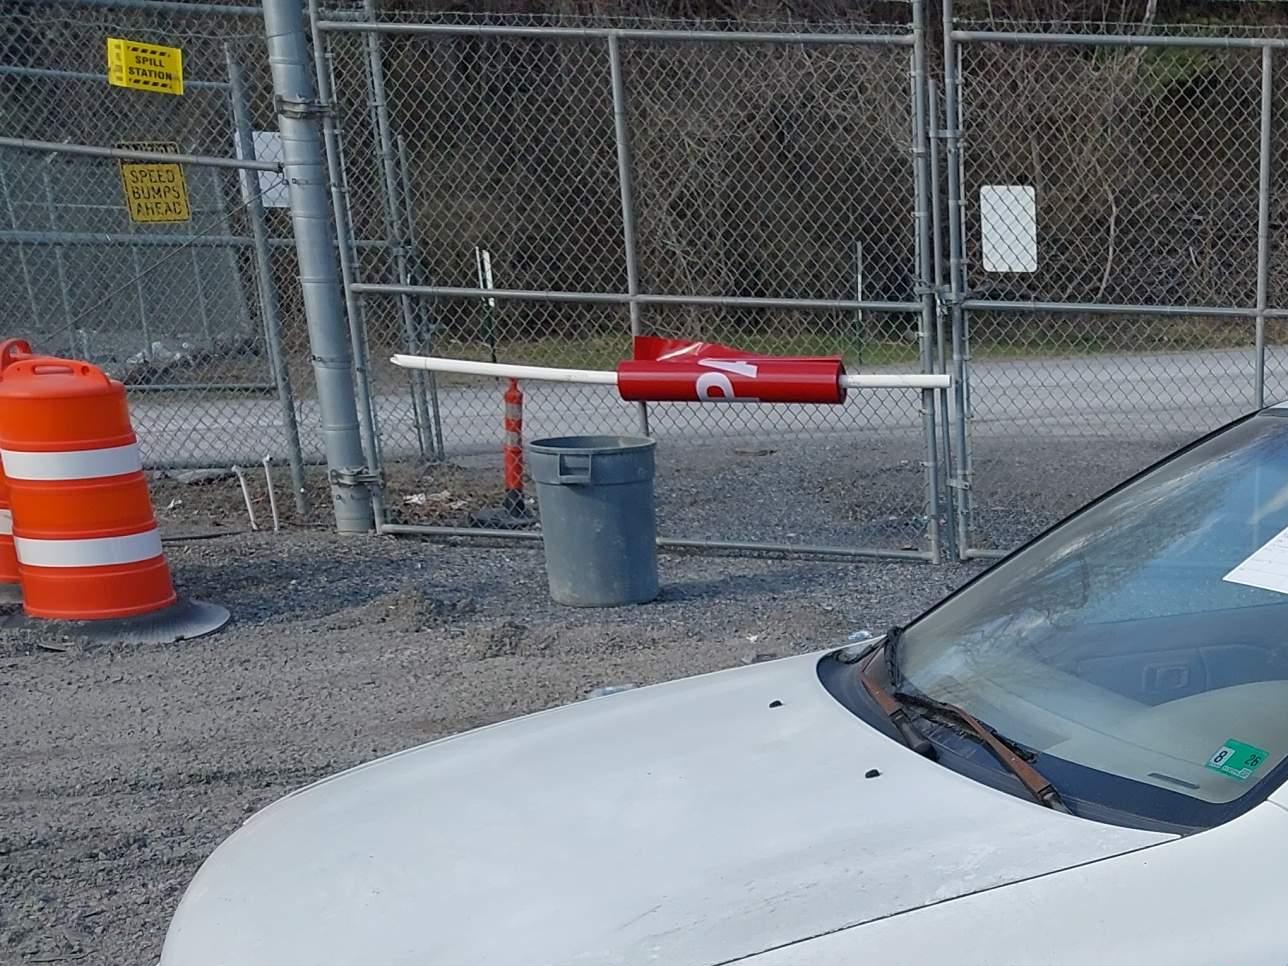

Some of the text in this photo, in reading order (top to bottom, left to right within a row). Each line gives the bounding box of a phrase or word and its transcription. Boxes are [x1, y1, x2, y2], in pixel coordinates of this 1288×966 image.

[135, 55, 166, 68] SPILL
[128, 66, 173, 81] STATION
[130, 169, 175, 184] SPEED
[131, 185, 181, 200] BUMPS
[136, 201, 182, 216] AHEAD
[1213, 750, 1229, 764] 8
[1244, 753, 1262, 767] 26
